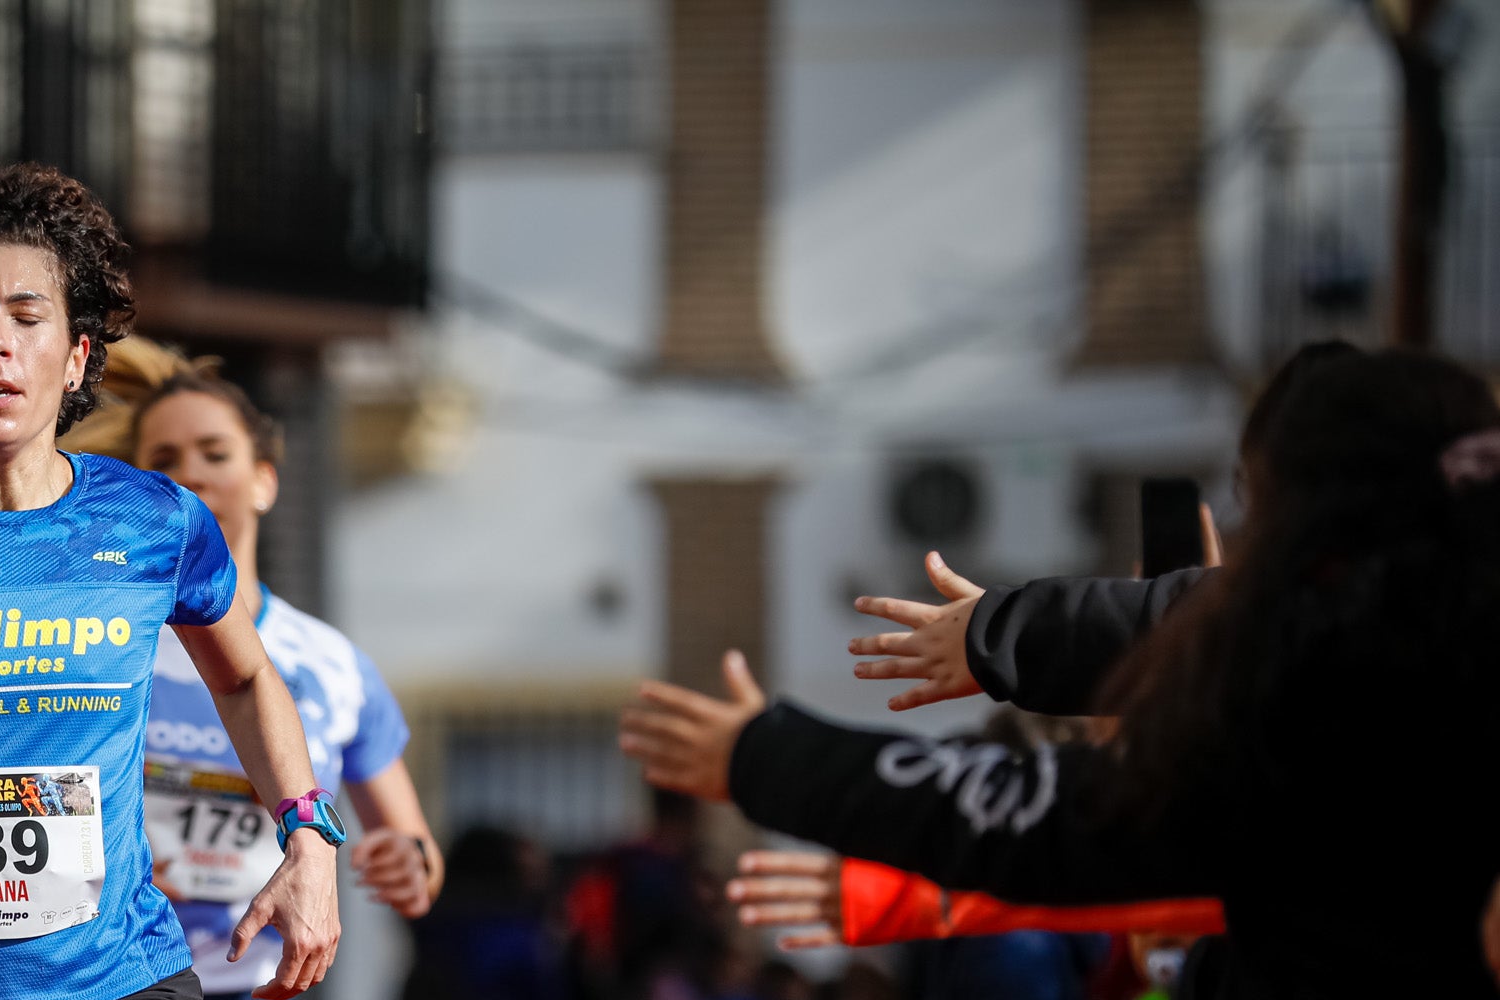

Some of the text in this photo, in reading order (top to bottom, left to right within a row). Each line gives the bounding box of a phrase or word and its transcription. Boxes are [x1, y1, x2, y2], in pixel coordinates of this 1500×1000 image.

[92, 551, 127, 565] 42K
[16, 698, 31, 714] &
[37, 696, 121, 714] RUNNING
[177, 804, 263, 848] 179
